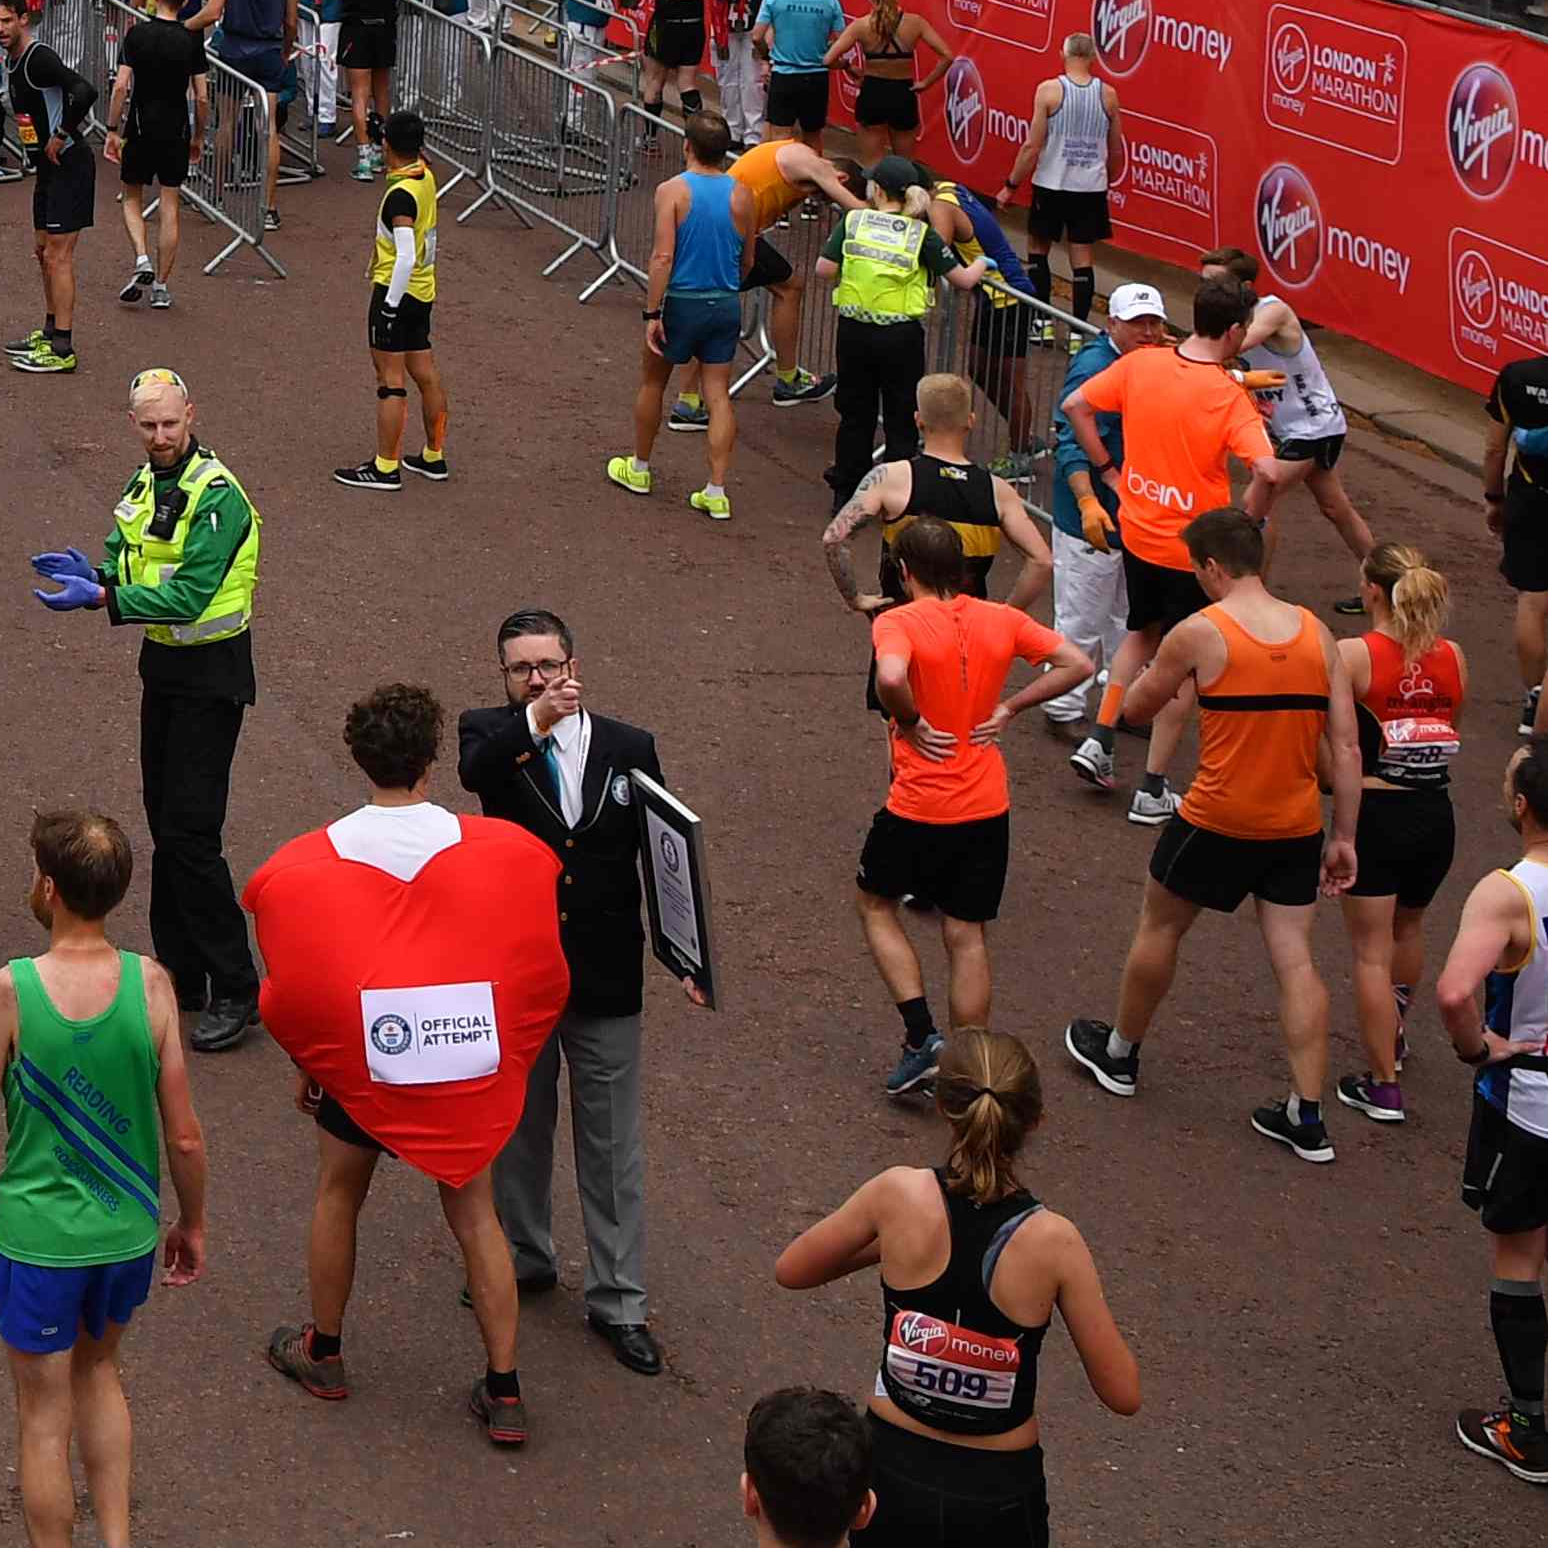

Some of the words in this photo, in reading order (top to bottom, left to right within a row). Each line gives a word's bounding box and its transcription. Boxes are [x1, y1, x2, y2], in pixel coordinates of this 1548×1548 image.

[1153, 13, 1232, 73] money
[1313, 43, 1376, 83] LONDON
[948, 69, 983, 148] Virgin
[988, 109, 1032, 145] mon
[1271, 93, 1306, 117] money
[1311, 71, 1397, 117] MARATHON
[1453, 77, 1513, 180] Virgin
[1131, 141, 1193, 177] LONDON
[1131, 165, 1210, 210] MARATHON
[1262, 177, 1316, 270] Virgin
[1328, 225, 1411, 295] money
[1498, 276, 1548, 315] LONDO
[420, 1014, 492, 1033] OFFICIAL
[422, 1029, 494, 1048] ATTEMPT
[61, 1065, 133, 1137] READING
[901, 1313, 946, 1353] Virgin
[951, 1337, 1017, 1364] money
[914, 1360, 988, 1401] 509
